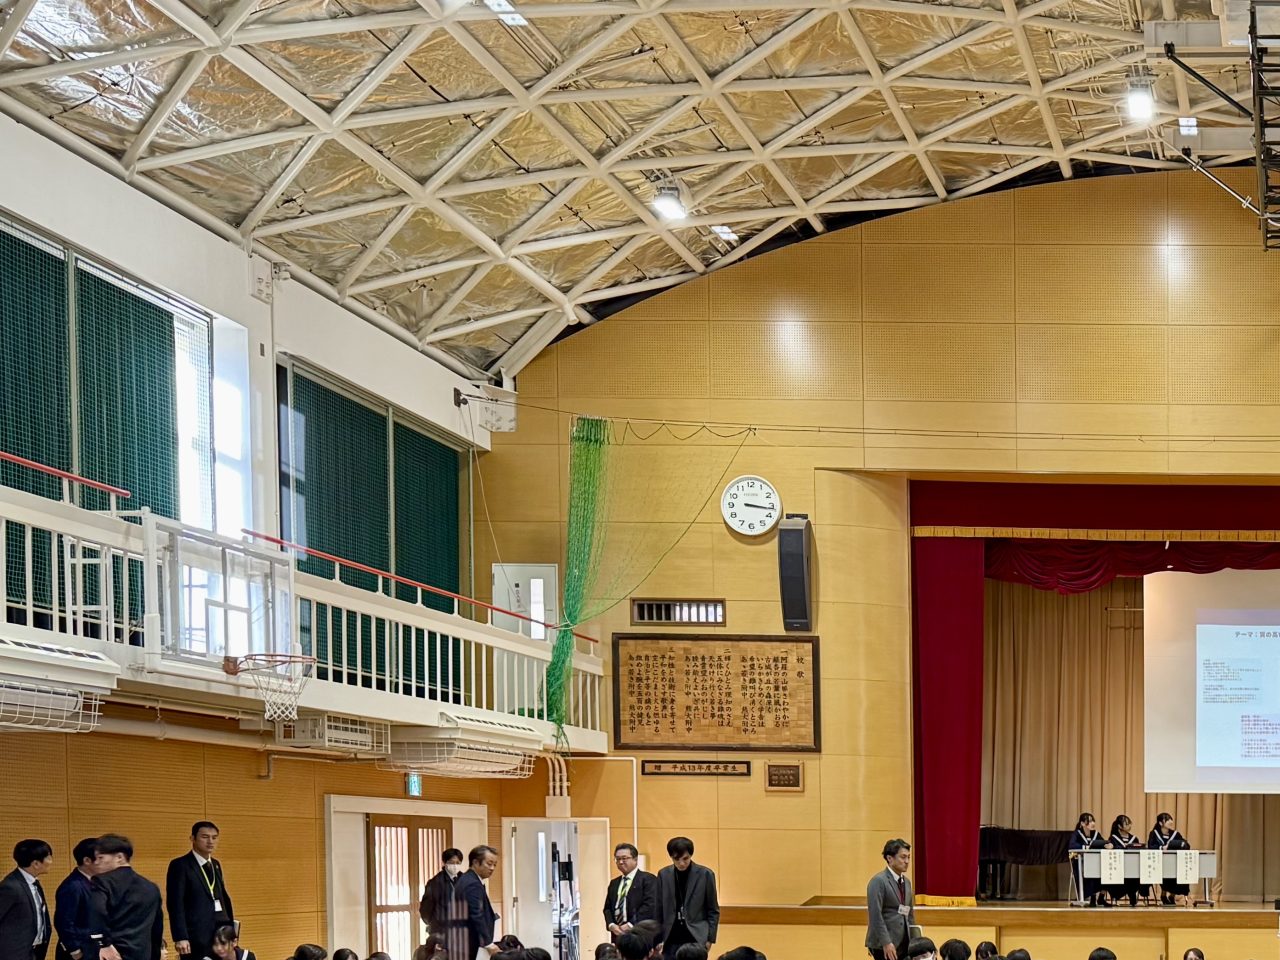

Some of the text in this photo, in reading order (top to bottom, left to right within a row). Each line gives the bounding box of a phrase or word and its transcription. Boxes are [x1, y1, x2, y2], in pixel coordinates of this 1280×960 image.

[671, 764, 739, 772] 平成13年度卒業生
